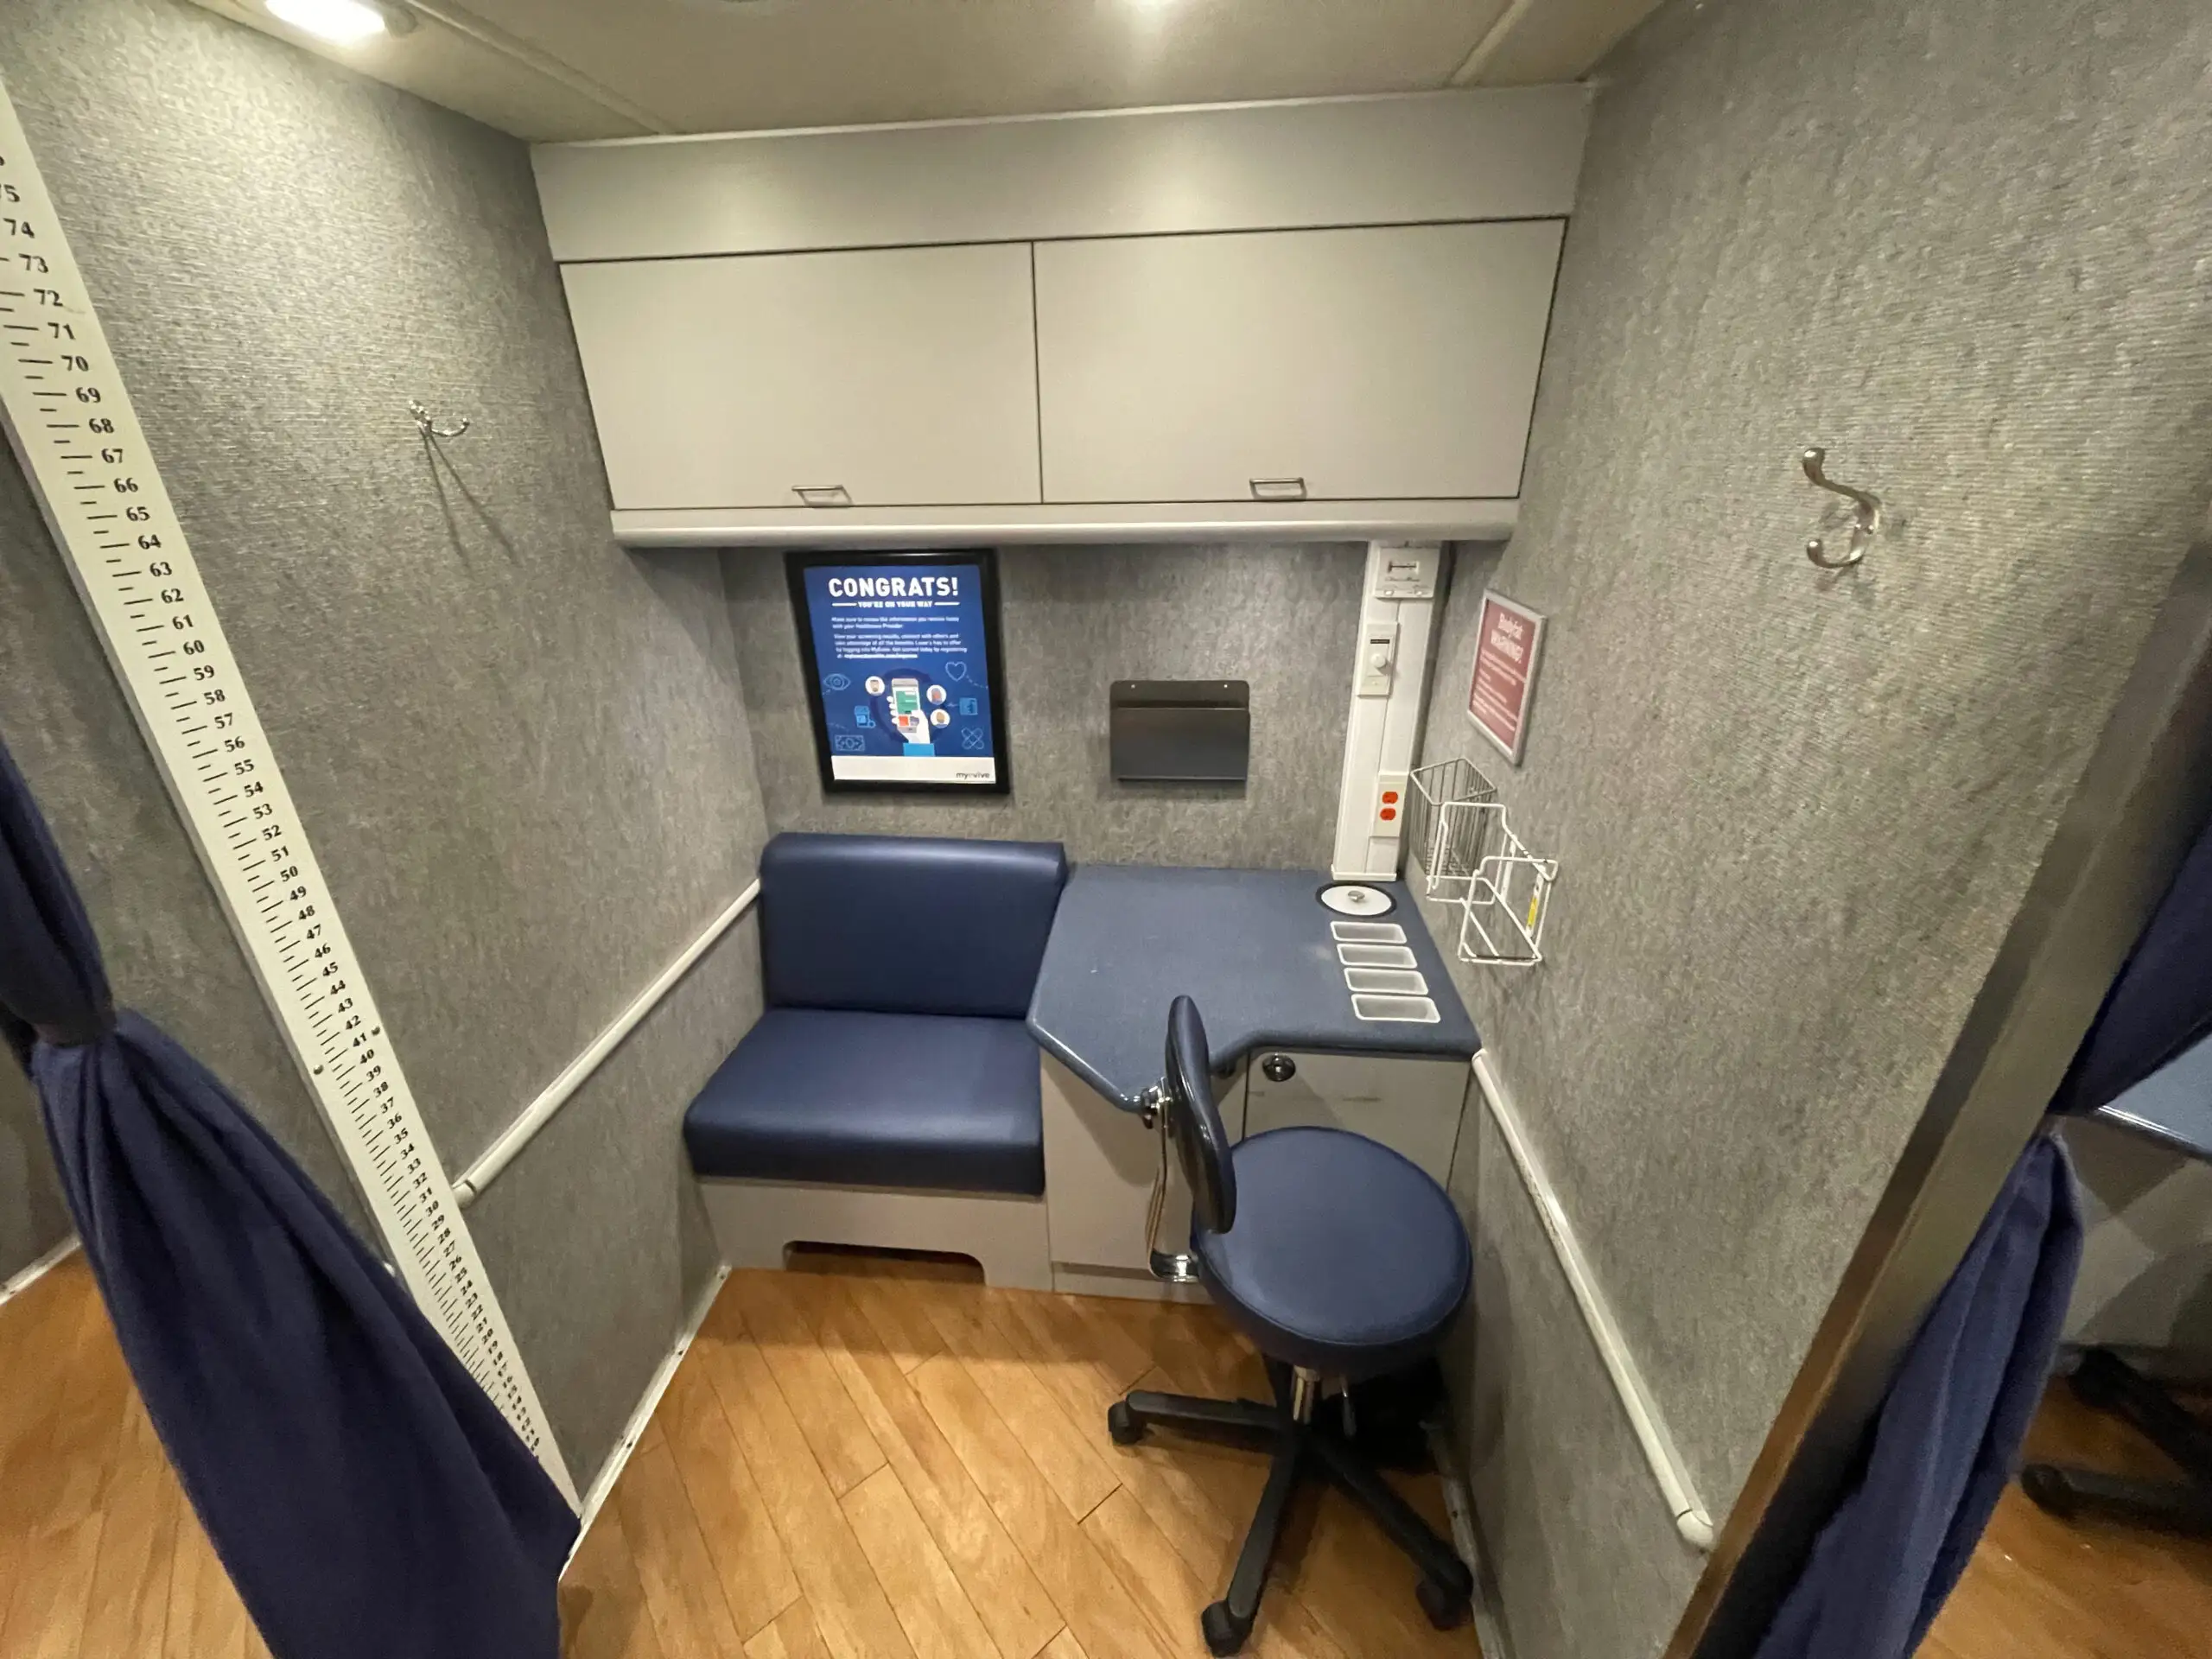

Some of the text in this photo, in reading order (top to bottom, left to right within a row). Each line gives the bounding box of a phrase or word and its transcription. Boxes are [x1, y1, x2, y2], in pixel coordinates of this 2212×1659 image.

[3, 219, 34, 238] 74
[19, 254, 48, 273] 73
[34, 289, 63, 307] 72
[48, 322, 74, 339] 71
[61, 355, 88, 371] 70
[76, 387, 100, 403] 69
[89, 418, 114, 433] 68
[102, 448, 123, 463] 67
[114, 478, 138, 493] 66
[126, 506, 149, 521] 65
[138, 535, 161, 550] 64
[150, 563, 172, 576] 63
[828, 577, 959, 597] CONGRATS!
[162, 588, 183, 603] 62
[173, 615, 193, 629] 61
[183, 640, 204, 655] 60
[194, 665, 214, 680] 59
[204, 690, 225, 705] 58
[214, 713, 232, 728] 57
[225, 736, 245, 752] 56
[235, 760, 254, 775] 55
[245, 782, 263, 797] 54
[253, 804, 272, 819] 53
[263, 825, 281, 840] 52
[271, 846, 289, 861] 51
[281, 866, 297, 881] 50
[290, 887, 306, 899] 49
[299, 906, 315, 919] 48
[307, 924, 321, 938] 47
[315, 944, 330, 957] 46
[323, 962, 338, 976] 45
[331, 980, 346, 995] 44
[339, 998, 353, 1013] 43
[346, 1015, 360, 1029] 42
[353, 1033, 366, 1046] 41
[359, 1049, 375, 1065] 40
[365, 1065, 381, 1082] 39
[373, 1082, 389, 1097] 38
[381, 1097, 394, 1114] 37
[386, 1114, 403, 1130] 36
[394, 1128, 409, 1145] 35
[400, 1143, 415, 1160] 34
[407, 1158, 422, 1174] 33
[413, 1173, 428, 1189] 32
[419, 1187, 433, 1204] 31
[425, 1201, 439, 1217] 30
[431, 1215, 445, 1231] 29
[437, 1228, 451, 1245] 28
[443, 1241, 455, 1258] 27
[449, 1255, 461, 1271] 26
[454, 1268, 467, 1284] 25
[460, 1281, 474, 1296] 24
